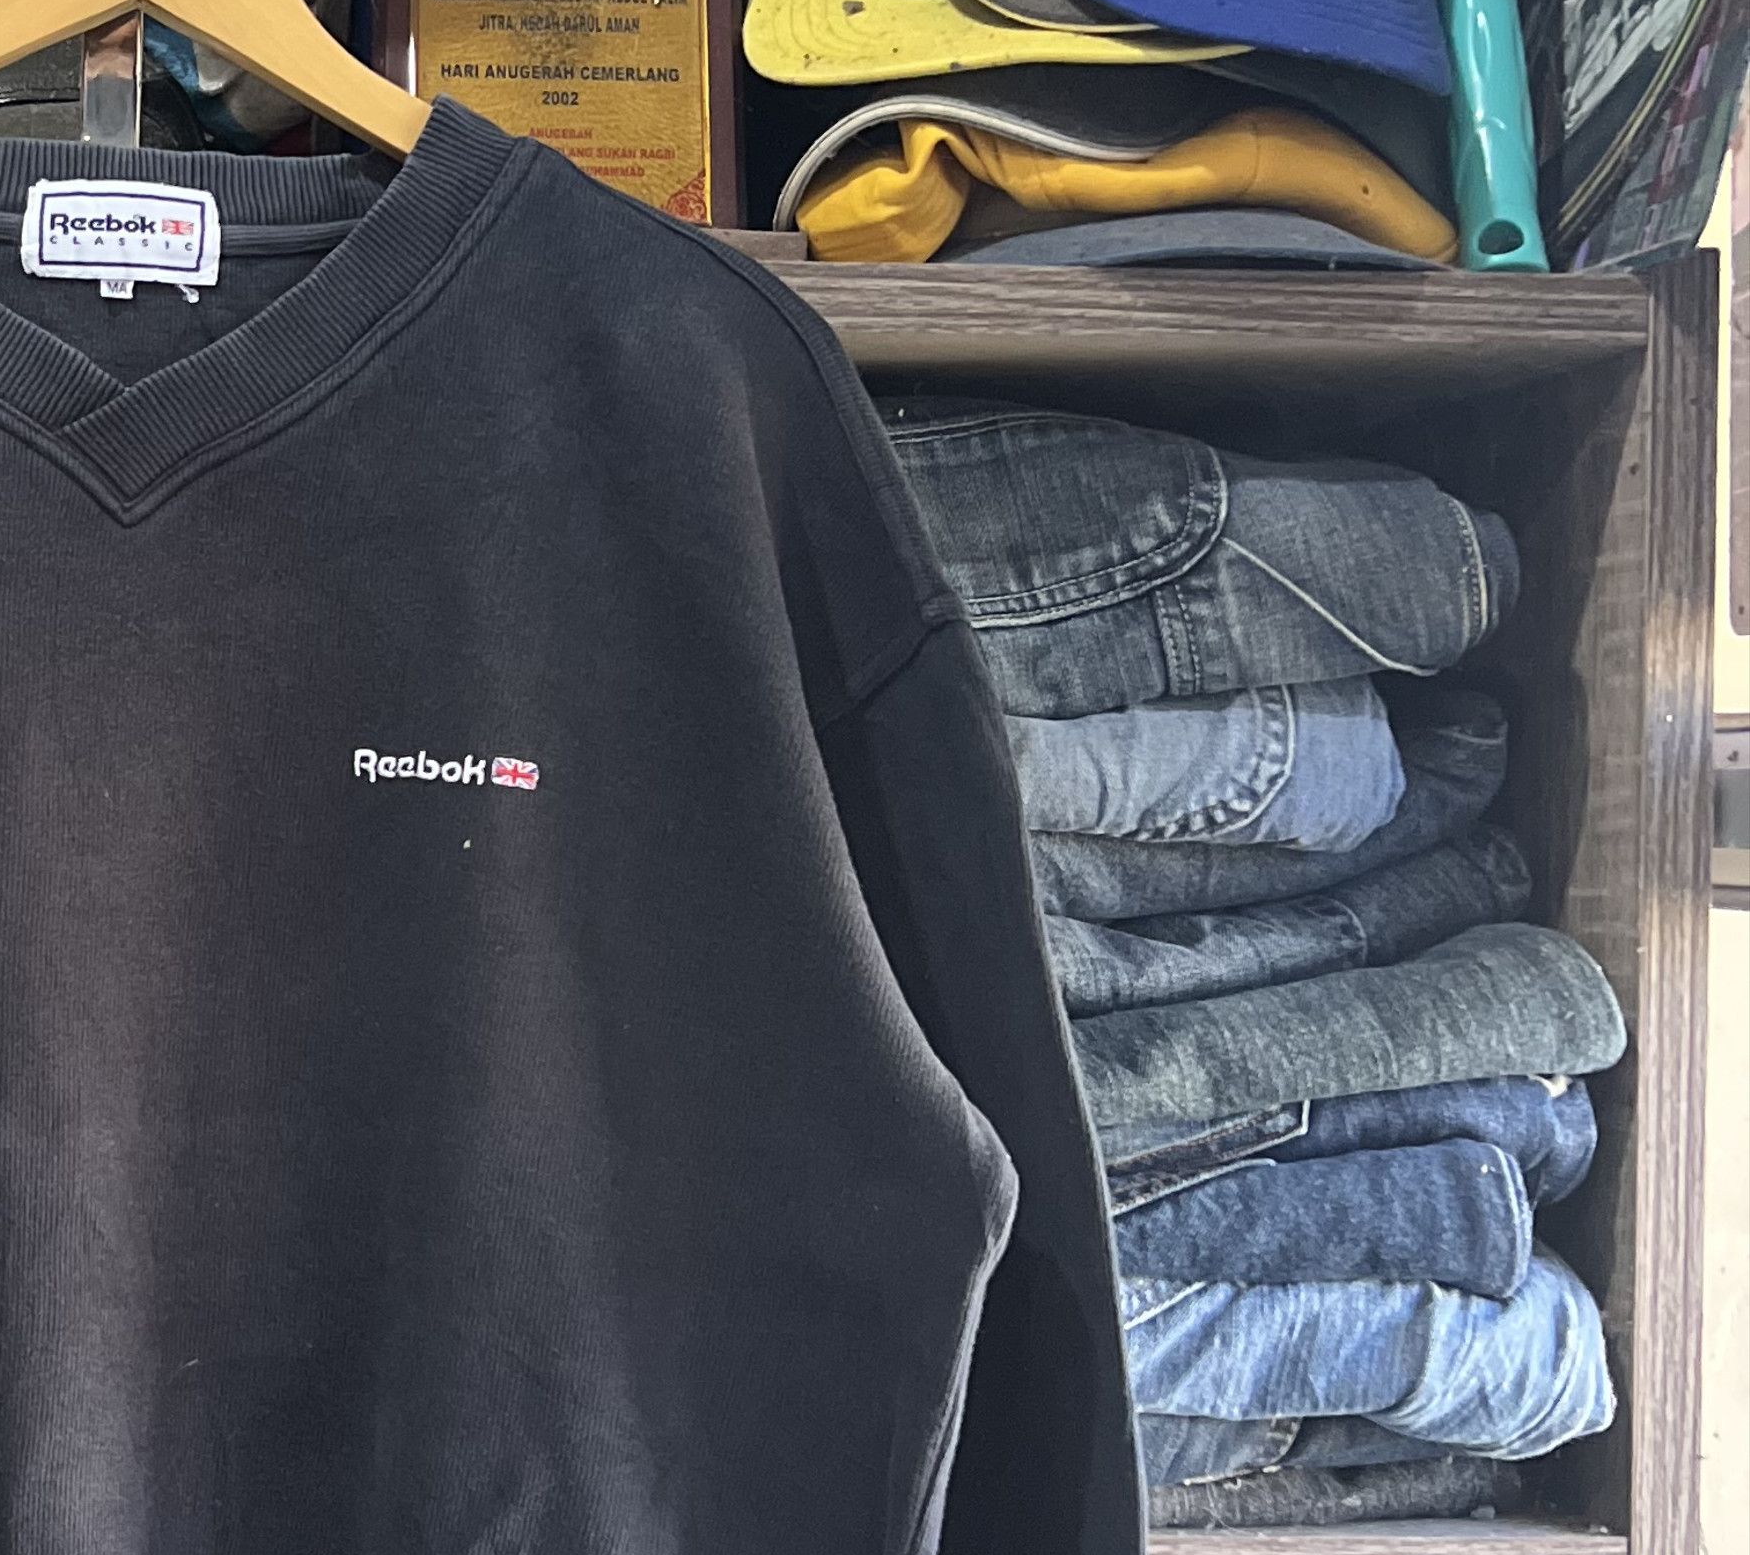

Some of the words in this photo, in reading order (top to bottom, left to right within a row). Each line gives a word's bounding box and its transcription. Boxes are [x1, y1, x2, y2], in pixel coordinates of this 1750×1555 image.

[606, 17, 640, 34] AMAN
[440, 64, 479, 79] HARI
[485, 65, 575, 81] ANUGERAH
[580, 66, 680, 83] CEMERLANG
[541, 90, 579, 105] 2002
[49, 213, 156, 235] Reebok
[49, 235, 193, 252] CLASSIC
[353, 748, 487, 786] Reebok
